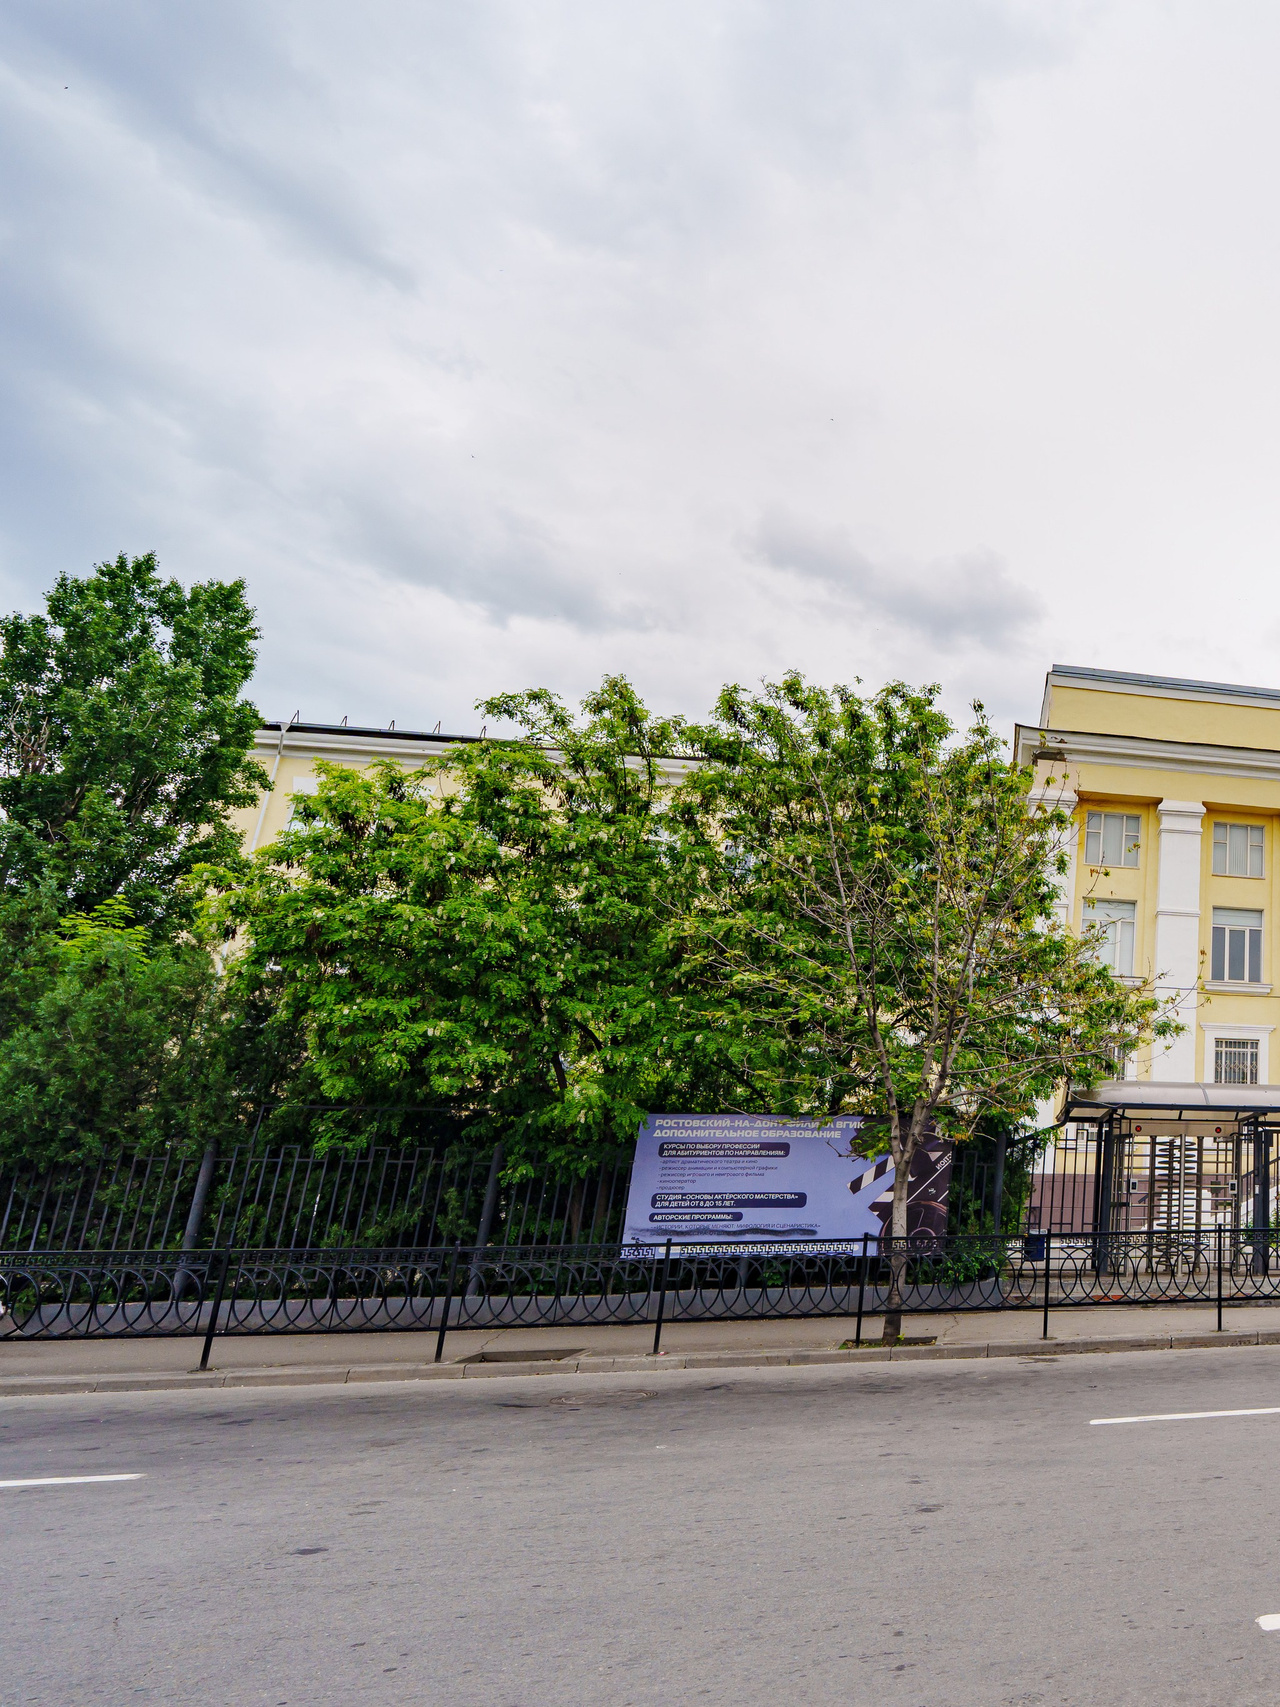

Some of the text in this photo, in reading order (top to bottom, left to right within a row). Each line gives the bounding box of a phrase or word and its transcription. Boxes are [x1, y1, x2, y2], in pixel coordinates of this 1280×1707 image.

[655, 1118, 865, 1129] РОСТОВСКИЙ-НА-ДОН ФИЛИЛ ВГИК
[653, 1129, 841, 1138] ДОПОЛНИТЕЛЬНОЕ ОБРАЗОВАНИЕ
